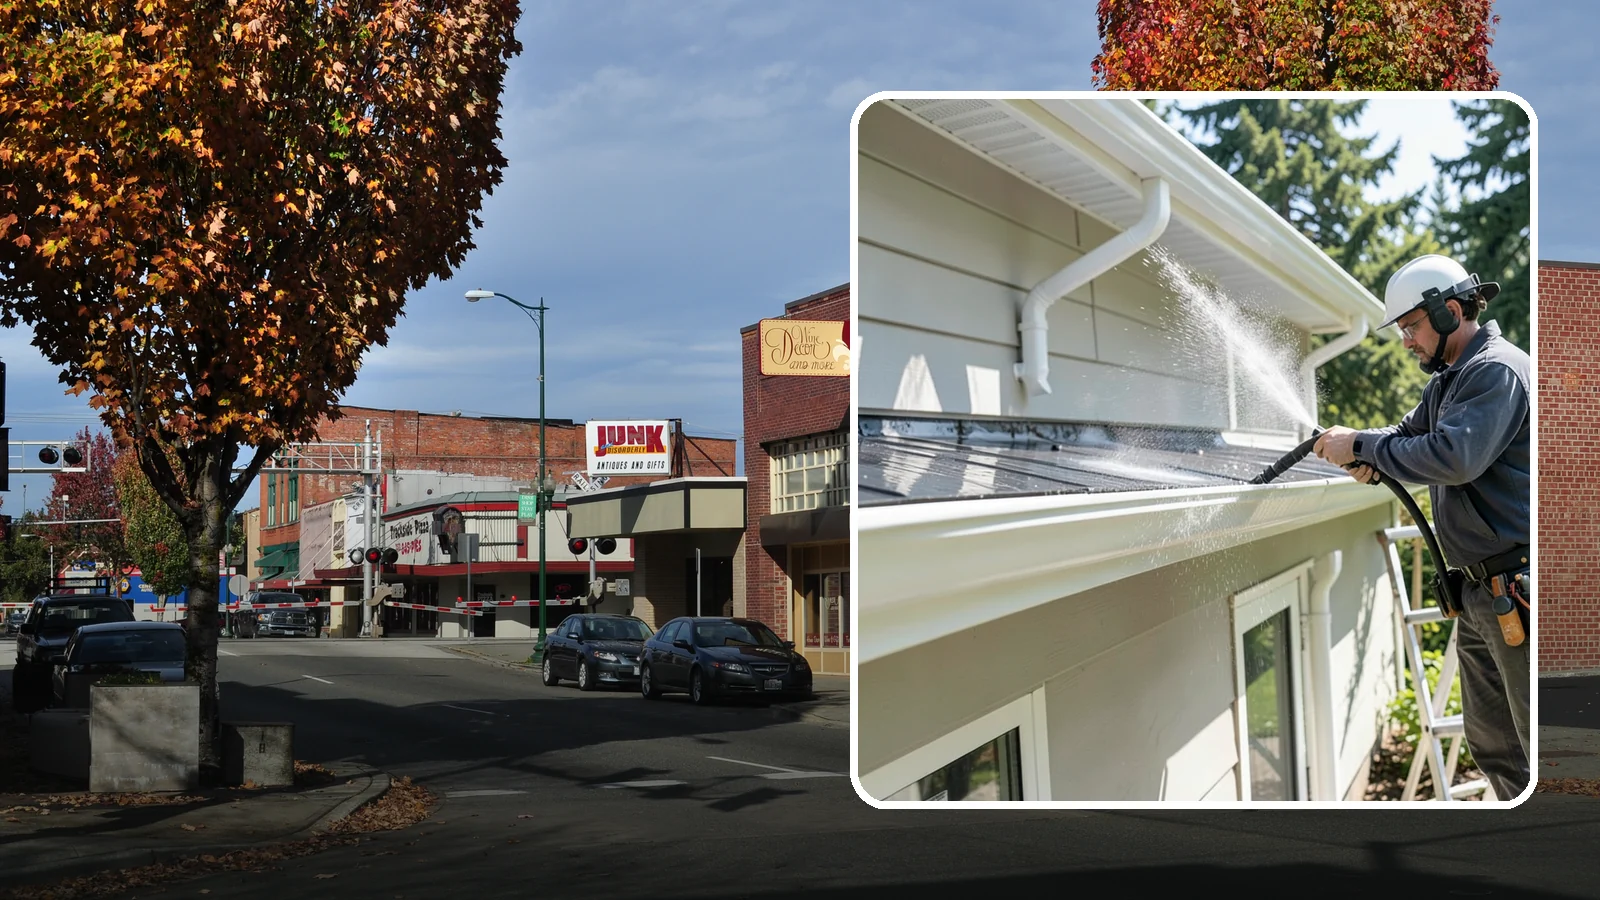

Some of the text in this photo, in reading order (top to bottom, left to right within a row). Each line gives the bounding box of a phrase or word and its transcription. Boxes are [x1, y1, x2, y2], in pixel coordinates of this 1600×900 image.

[596, 426, 664, 457] JUNK
[608, 446, 646, 454] DISORDERLY
[596, 460, 665, 470] ANTIQUES AND GIFTS
